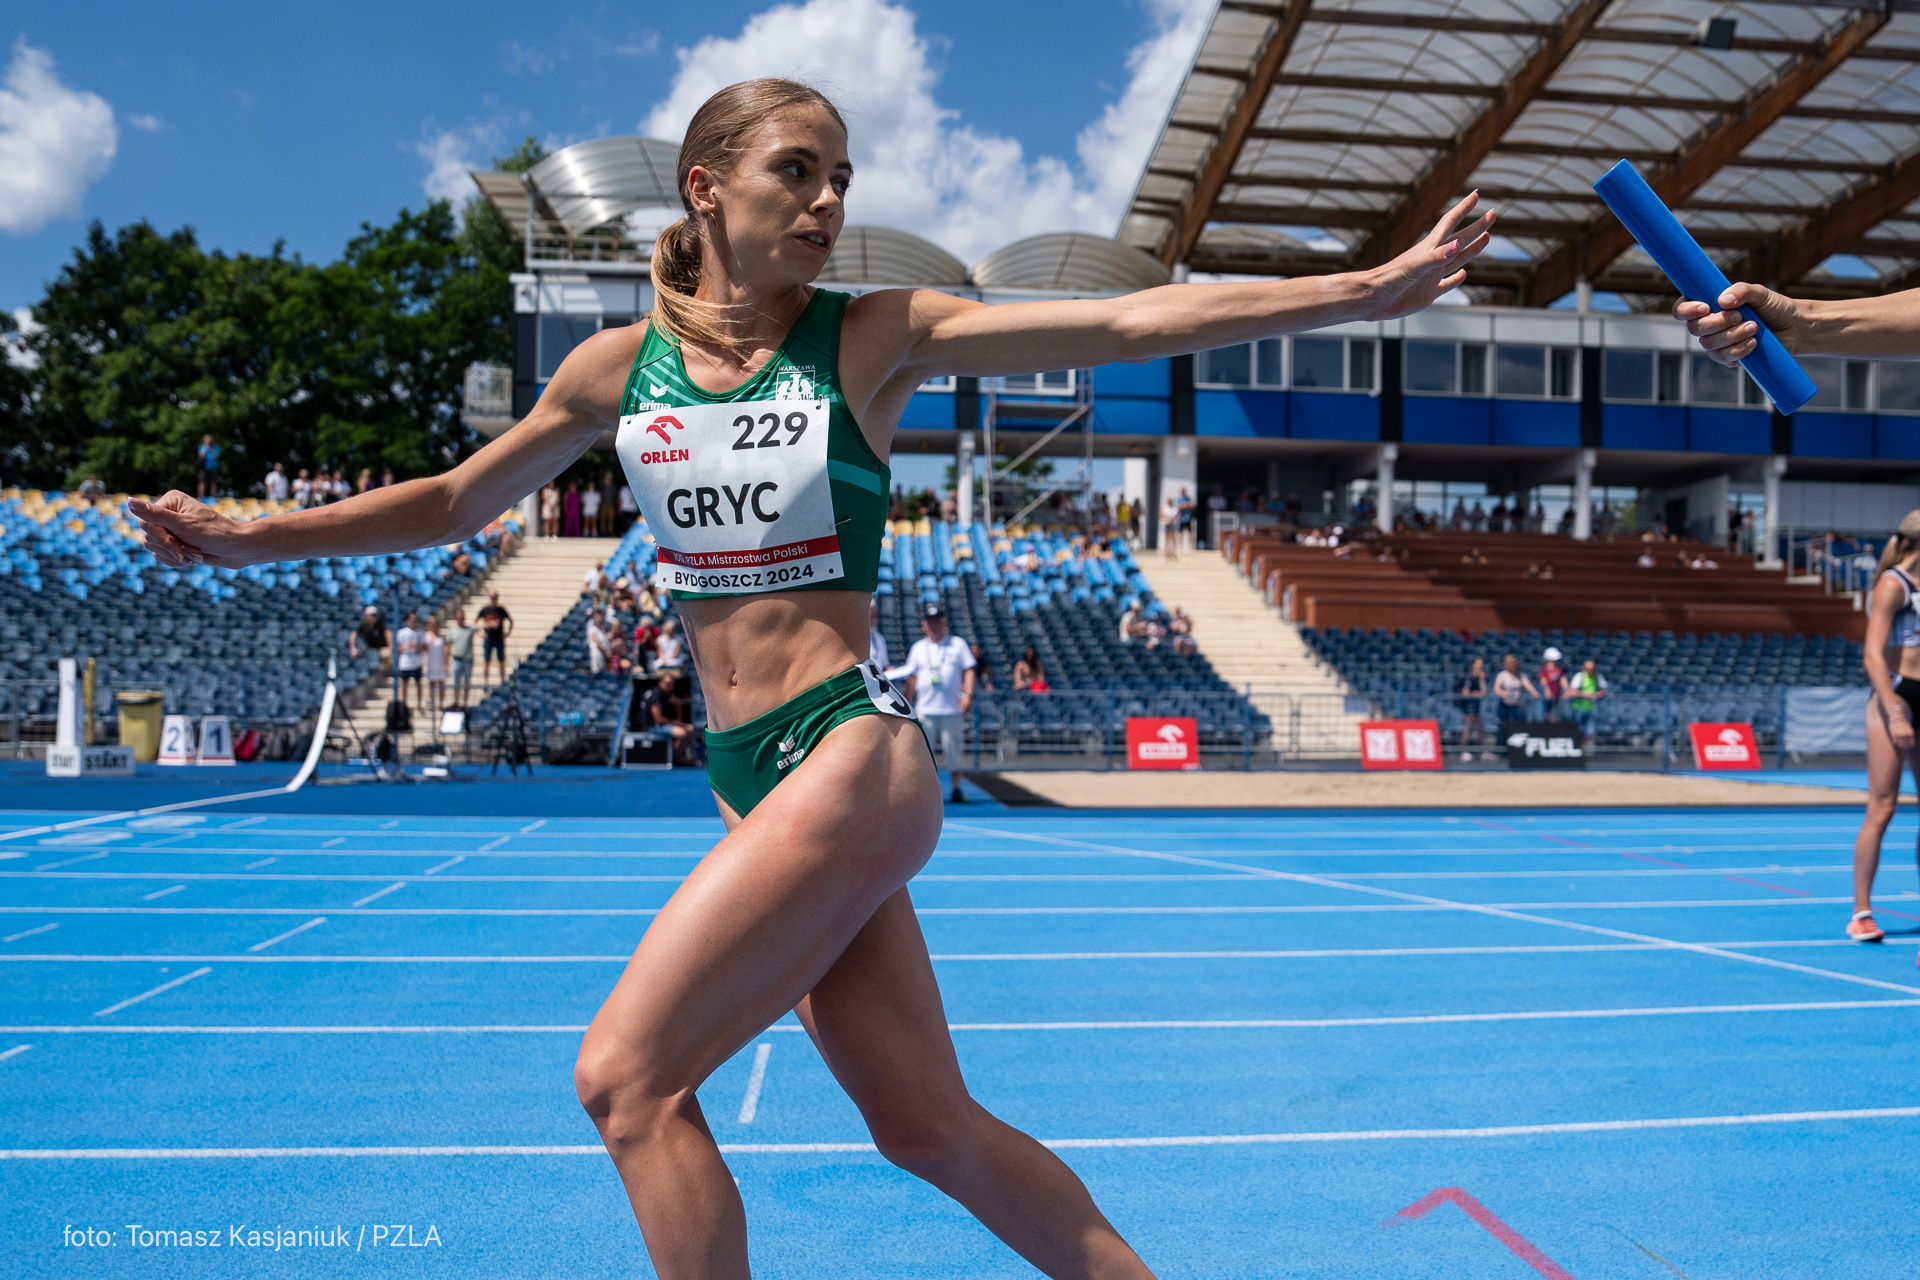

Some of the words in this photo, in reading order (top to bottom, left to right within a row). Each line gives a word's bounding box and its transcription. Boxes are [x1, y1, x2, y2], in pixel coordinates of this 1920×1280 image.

[639, 400, 671, 411] erima
[732, 411, 809, 451] 229
[641, 448, 690, 465] ORLEN
[667, 481, 781, 529] GRYC
[707, 552, 771, 566] Mistrzostwa
[774, 543, 808, 560] Polski
[675, 571, 763, 588] BYDGOSZCZ
[766, 563, 815, 586] 2024
[167, 726, 180, 752] 2
[209, 726, 223, 753] 1
[1525, 737, 1583, 758] FUEL
[777, 748, 805, 770] erima
